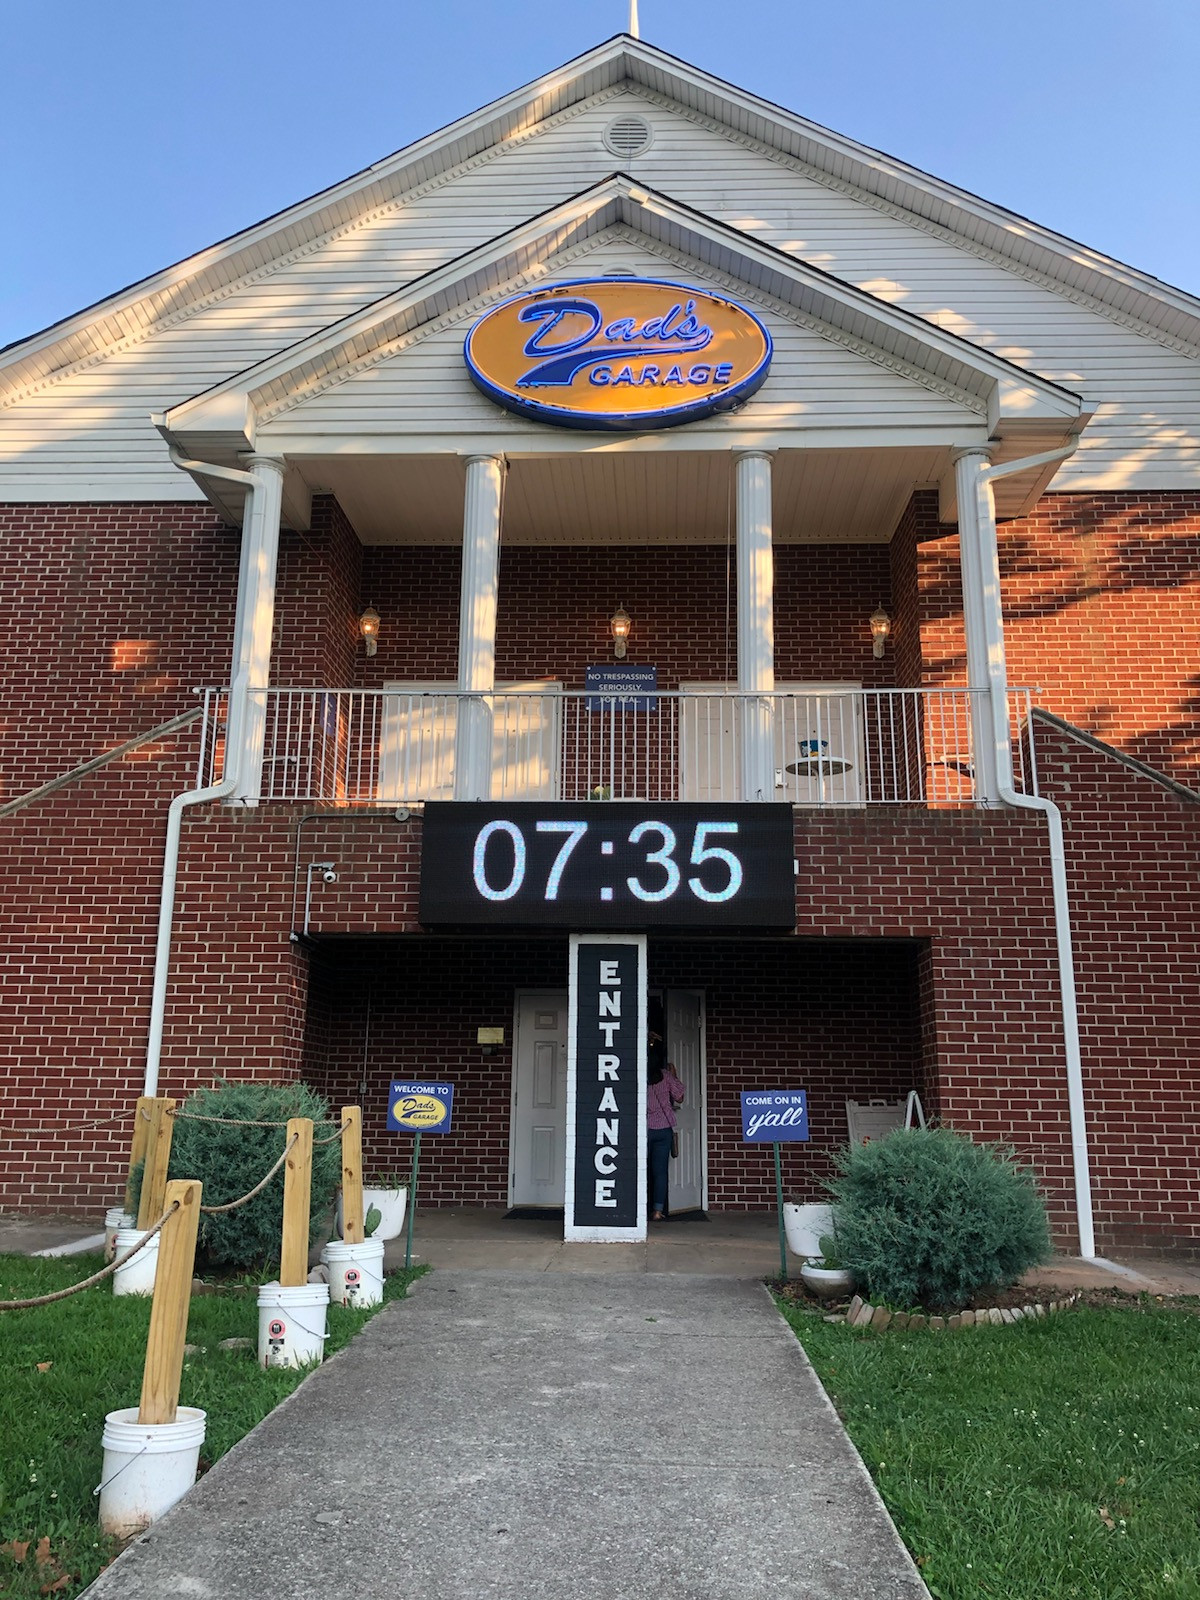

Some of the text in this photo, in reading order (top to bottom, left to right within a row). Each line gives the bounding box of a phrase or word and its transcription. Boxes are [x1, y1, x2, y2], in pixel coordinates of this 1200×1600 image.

[517, 297, 713, 358] Dad's
[588, 361, 734, 386] GARAGE
[588, 673, 654, 681] NO TRESPASSING
[598, 683, 643, 691] SERIOUSLY.
[473, 819, 743, 902] 07:35
[394, 1085, 449, 1095] WELCOME TO
[594, 960, 621, 1208] ENTRANCE
[745, 1096, 801, 1106] COME ON IN
[746, 1107, 803, 1137] y'all
